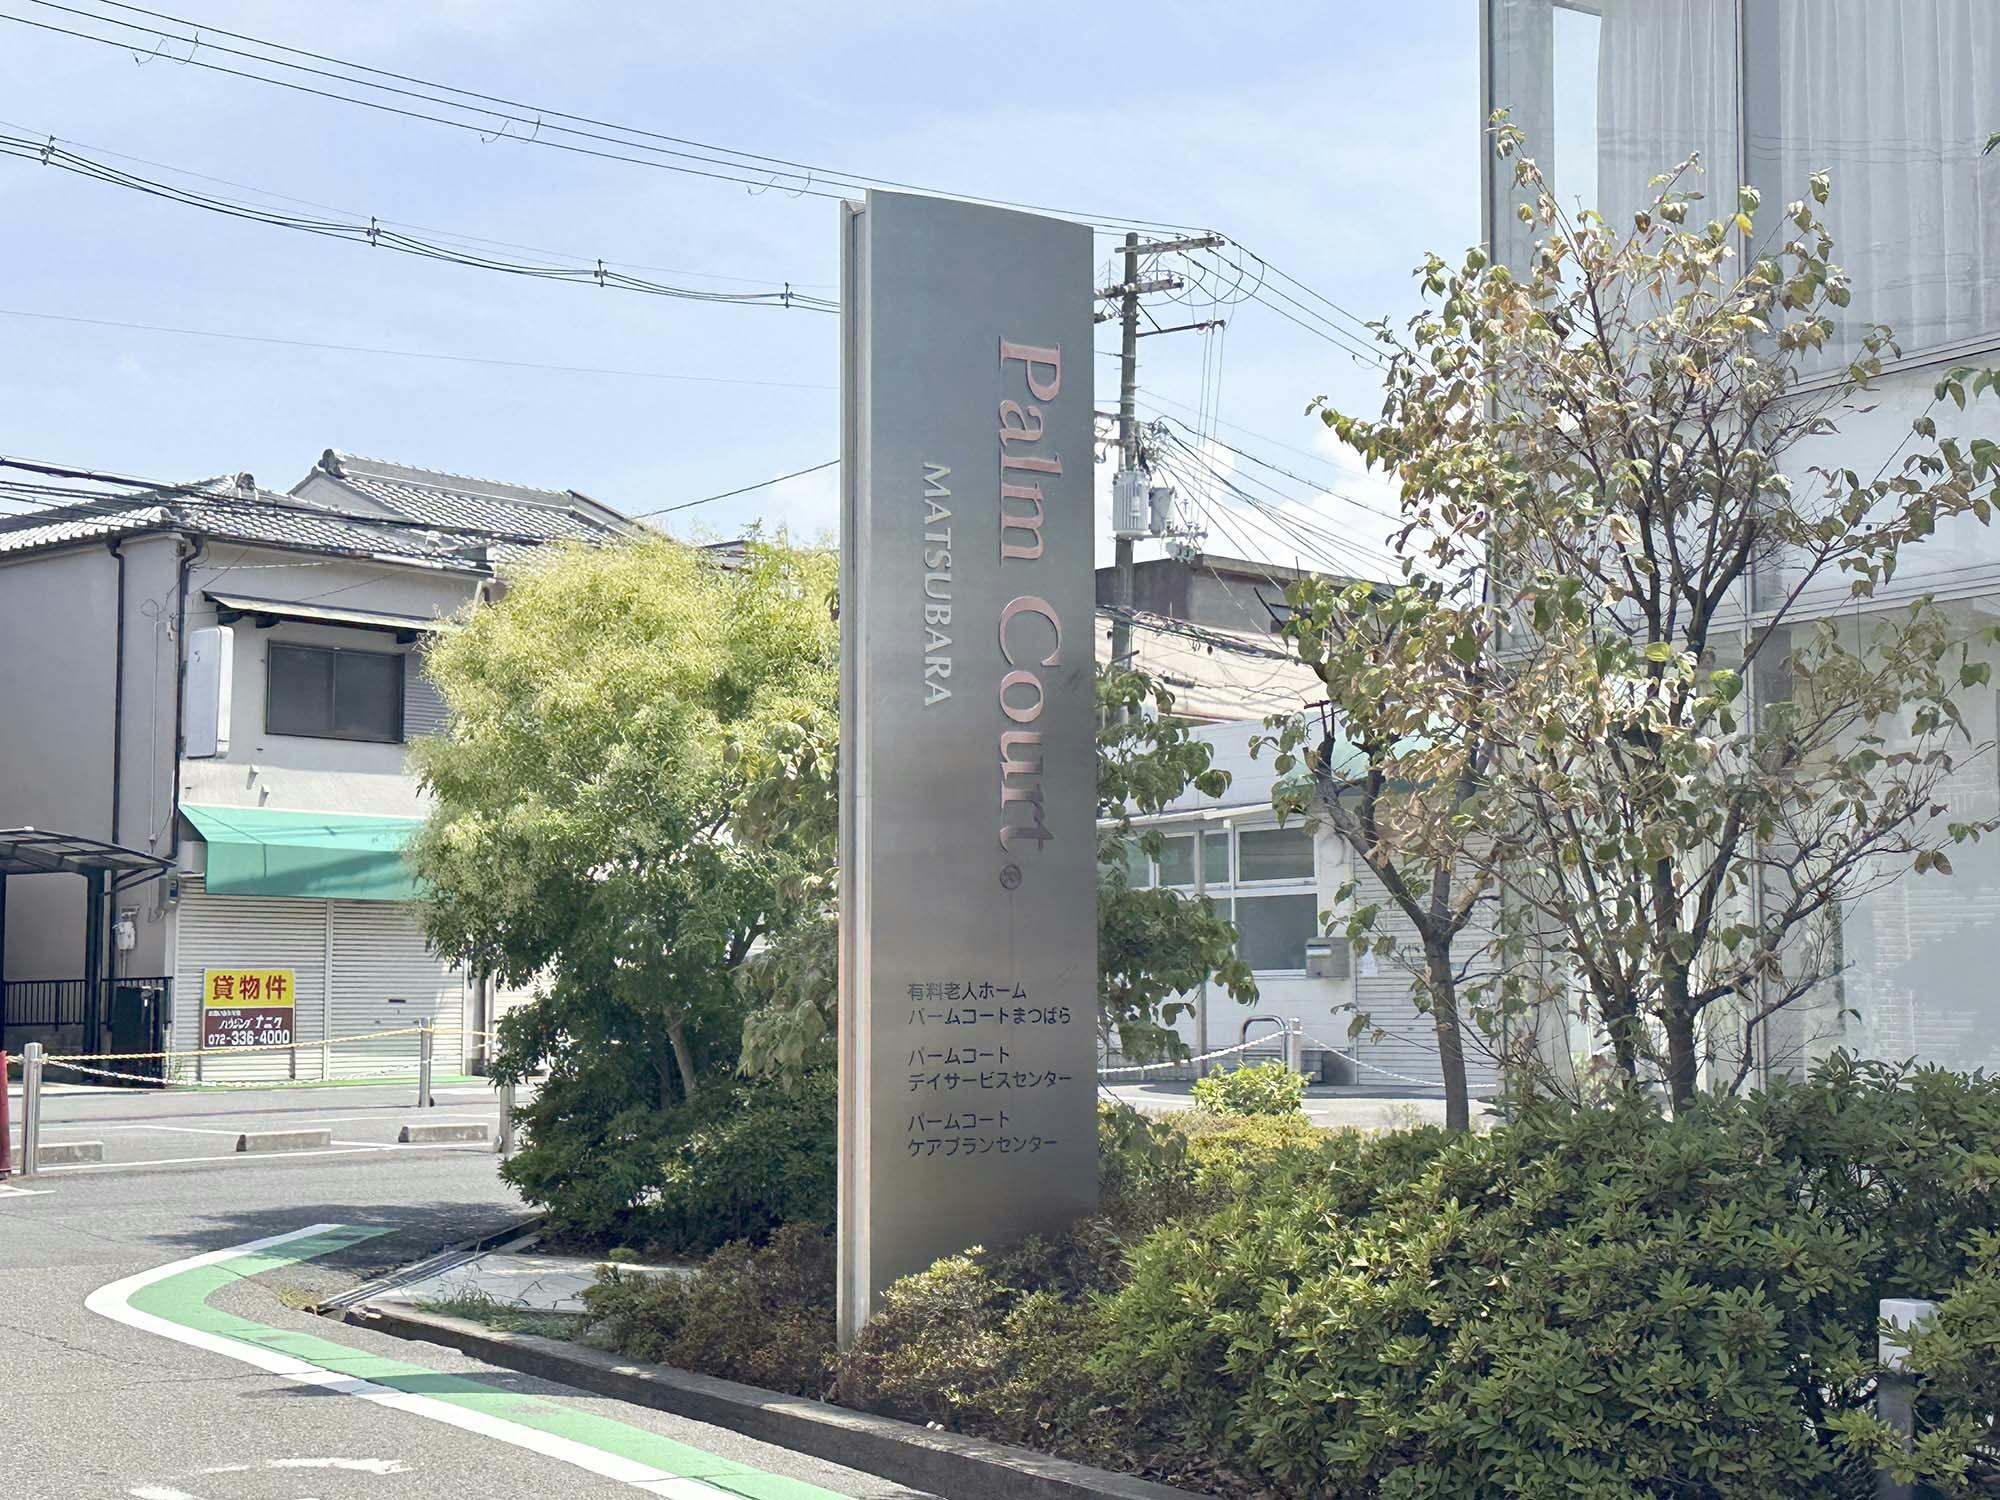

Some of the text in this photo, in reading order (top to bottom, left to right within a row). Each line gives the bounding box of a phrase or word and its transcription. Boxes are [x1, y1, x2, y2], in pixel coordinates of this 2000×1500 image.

[998, 336, 1063, 561] Palm
[923, 461, 953, 706] MATSUBARA
[998, 595, 1062, 853] Court
[212, 974, 287, 1001] 貸物件
[908, 981, 1027, 1001] 有料老人ホーム
[208, 1029, 290, 1046] 072-336-4000
[908, 1071, 1072, 1092] デイサービスセンター
